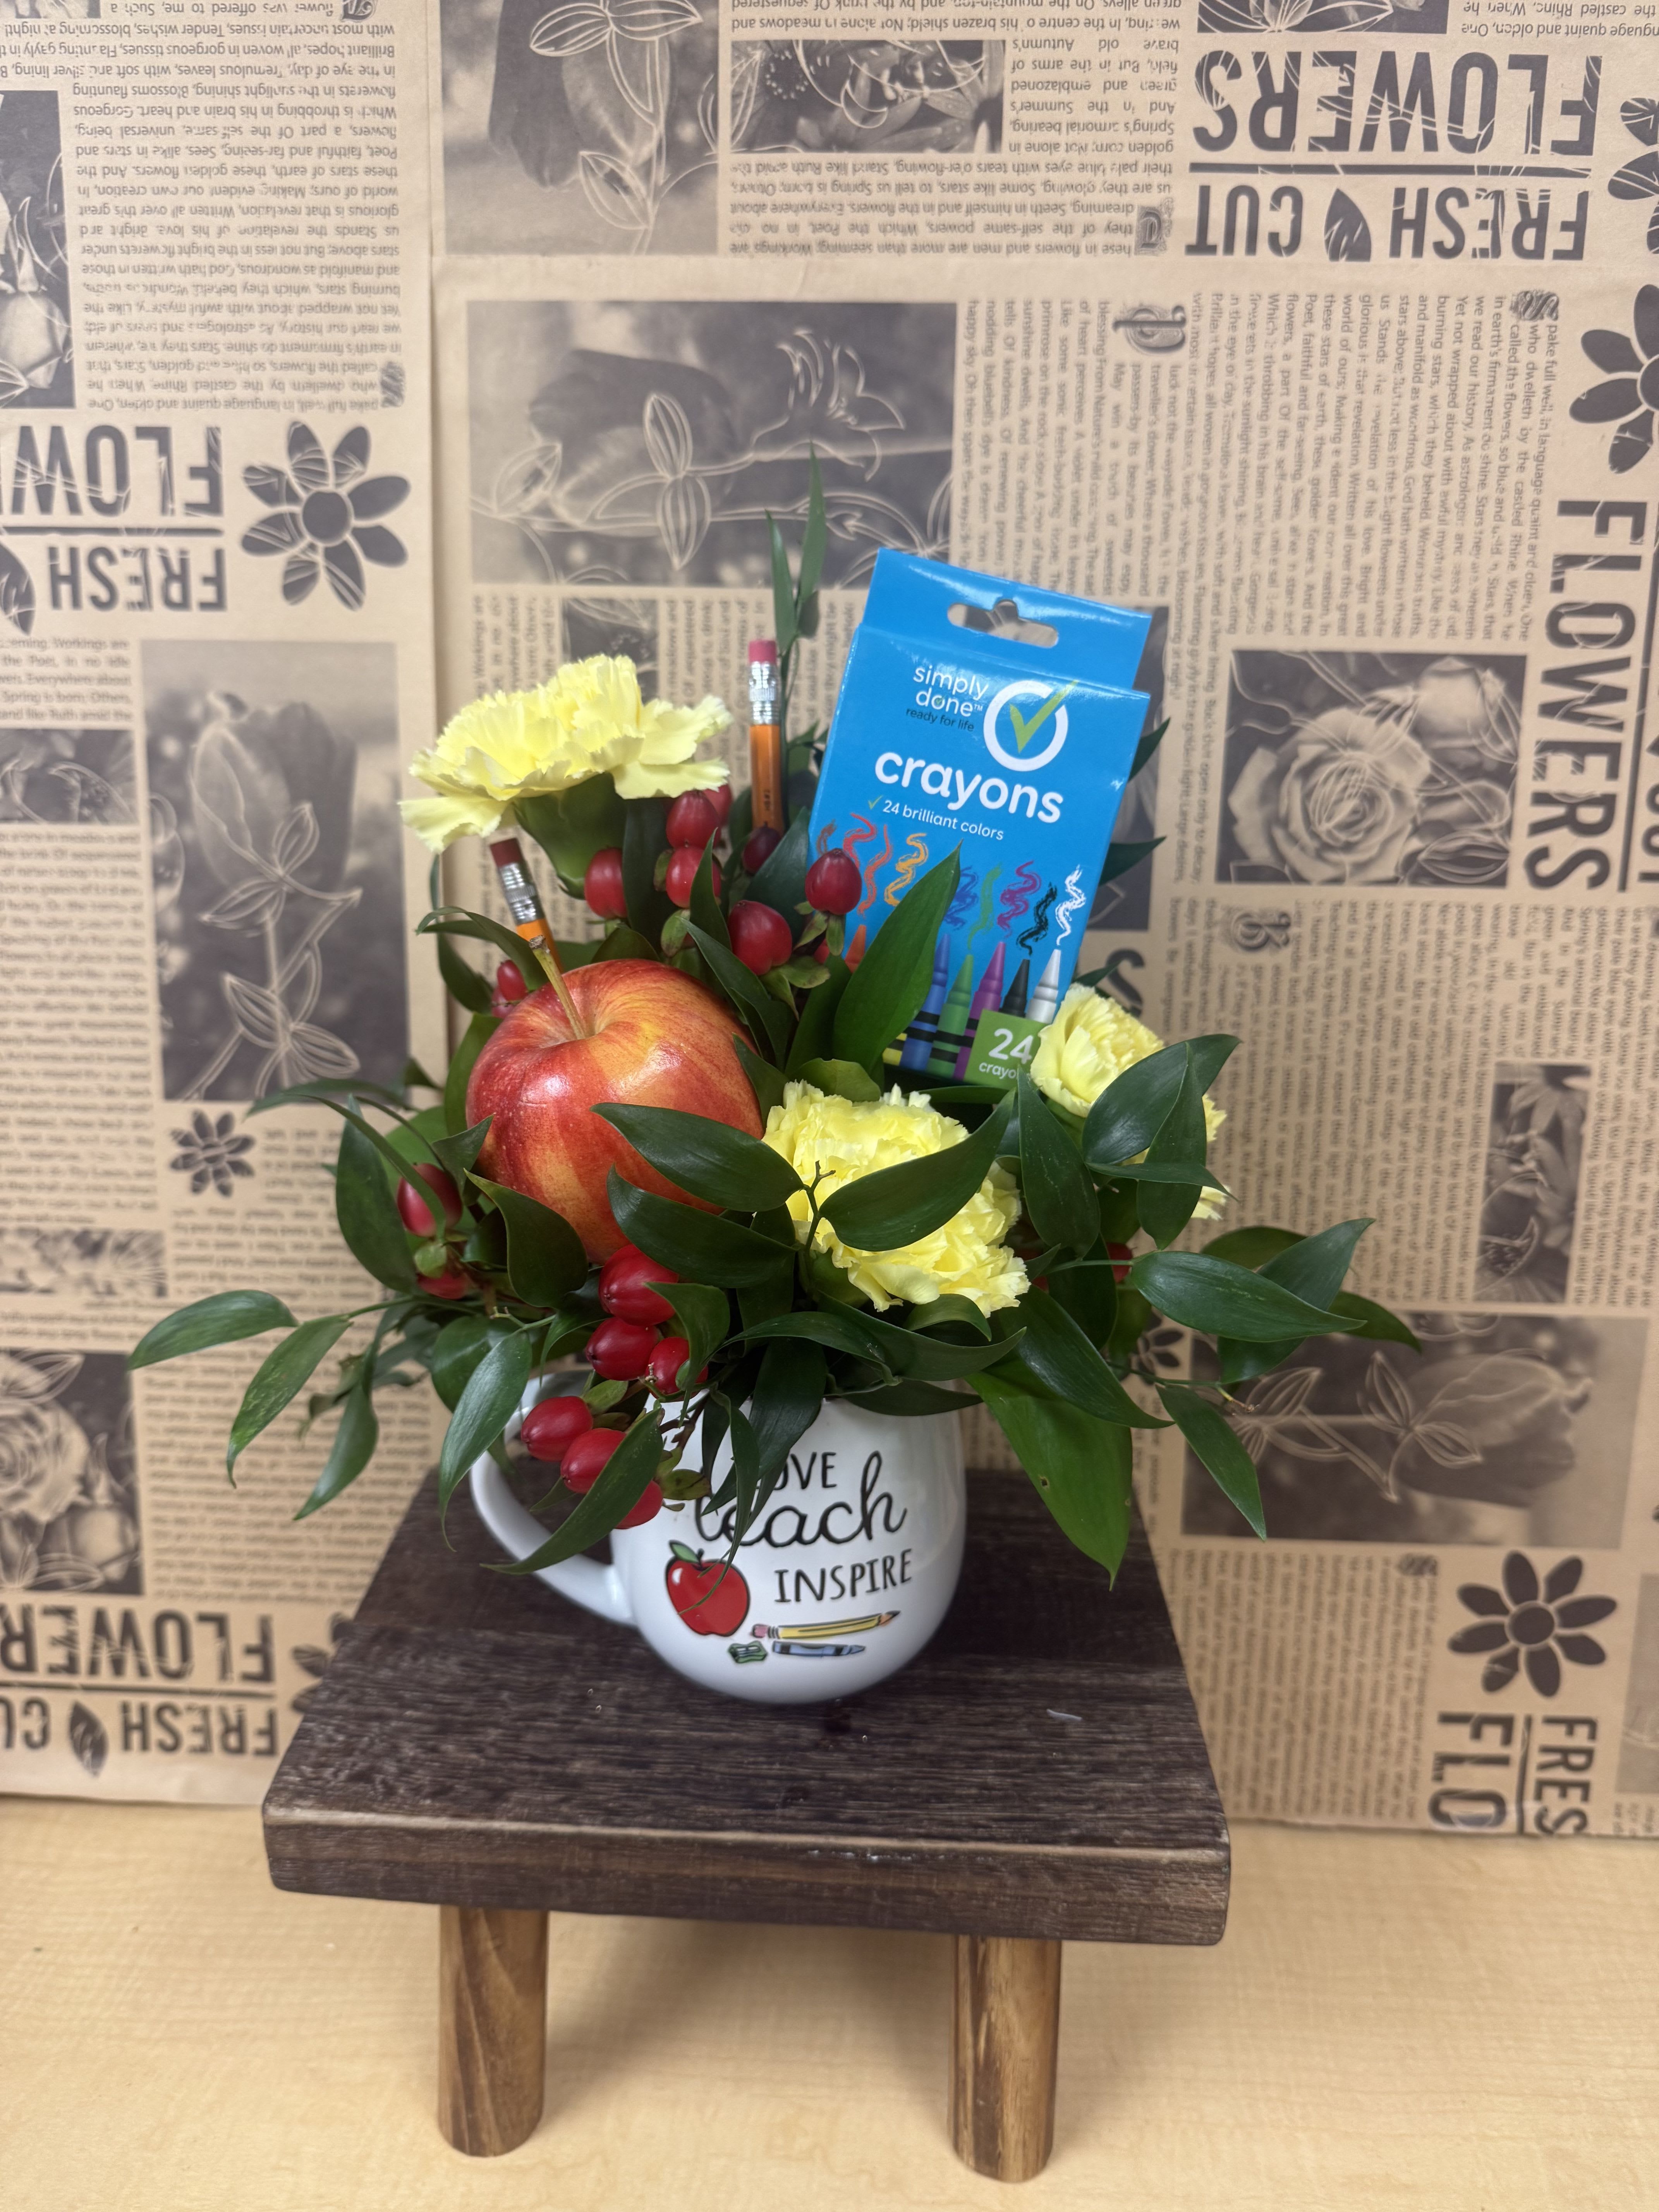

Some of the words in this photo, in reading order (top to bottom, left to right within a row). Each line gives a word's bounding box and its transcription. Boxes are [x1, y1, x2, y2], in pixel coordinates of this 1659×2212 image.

[191, 3, 205, 14] to
[211, 3, 256, 17] offered
[1580, 4, 1626, 18] castled
[1634, 5, 1656, 19] the
[332, 24, 363, 35] most
[731, 18, 756, 33] and
[759, 17, 821, 31] meadows
[952, 18, 996, 31] brazen
[1039, 17, 1080, 29] centre
[181, 24, 225, 38] Tender
[367, 24, 395, 38] with
[1536, 24, 1562, 39] and
[1564, 22, 1607, 39] quaint
[166, 41, 226, 55] gorgeous
[227, 45, 240, 57] in
[242, 45, 285, 55] woven
[347, 45, 395, 58] Brilliant
[1012, 38, 1075, 52] Autumn's
[1098, 38, 1120, 53] old
[1011, 59, 1025, 74] of
[1031, 59, 1064, 70] arms
[116, 65, 140, 79] soft
[143, 65, 172, 79] with
[72, 82, 128, 99] flaunting
[1011, 80, 1092, 94] emblazoned
[1103, 80, 1128, 94] and
[1011, 101, 1074, 114] Summer's
[1087, 101, 1109, 115] the
[1149, 101, 1176, 115] And
[1192, 50, 1602, 156] FLOWERS
[203, 106, 236, 119] brain
[239, 106, 258, 119] his
[261, 106, 273, 118] in
[277, 103, 340, 120] throbbing
[343, 106, 354, 119] is
[119, 125, 175, 139] universal
[249, 126, 271, 139] the
[278, 126, 294, 139] Of
[301, 124, 327, 137] part
[1123, 118, 1175, 136] Spring's
[136, 146, 148, 159] in
[289, 146, 313, 159] and
[317, 146, 362, 160] faithful
[1024, 142, 1061, 156] alone
[1128, 139, 1174, 156] golden
[76, 165, 98, 179] the
[101, 166, 127, 179] And
[311, 166, 326, 180] of
[330, 166, 359, 177] stars
[363, 166, 398, 179] these
[976, 162, 1008, 174] tears
[1012, 162, 1040, 176] with
[1044, 160, 1073, 173] eyes
[1142, 163, 1171, 177] their
[77, 185, 90, 198] In
[182, 185, 204, 196] our
[344, 186, 359, 200] of
[362, 186, 399, 199] world
[831, 179, 872, 196] Spring
[895, 182, 915, 196] tell
[919, 182, 933, 194] to
[973, 182, 996, 196] like
[999, 182, 1036, 196] Some
[1132, 183, 1153, 193] are
[965, 203, 1012, 216] himself
[1030, 203, 1066, 216] Seeth
[1185, 185, 1305, 256] CUT
[1389, 187, 1589, 261] FRESH
[983, 223, 1044, 237] self-same
[1052, 222, 1074, 236] the
[1082, 223, 1097, 238] of
[1103, 221, 1132, 236] they
[217, 245, 239, 258] the
[240, 245, 252, 257] in
[303, 245, 325, 258] But
[371, 245, 400, 257] stars
[47, 546, 227, 612] FRESH
[913, 665, 988, 700] simply
[1523, 499, 1649, 891] FLOWERS
[906, 708, 937, 724] ready
[939, 714, 956, 727] for
[958, 719, 974, 732] life
[875, 751, 1063, 823] crayons
[883, 800, 899, 814] 24
[903, 805, 957, 829] brilliant
[961, 822, 1004, 840] colors
[988, 1028, 1033, 1064] 24
[979, 1062, 1018, 1079] crayo
[773, 1548, 913, 1603] INSPIRE
[119, 1699, 279, 1757] FRESH
[1427, 1711, 1515, 1831] FLO
